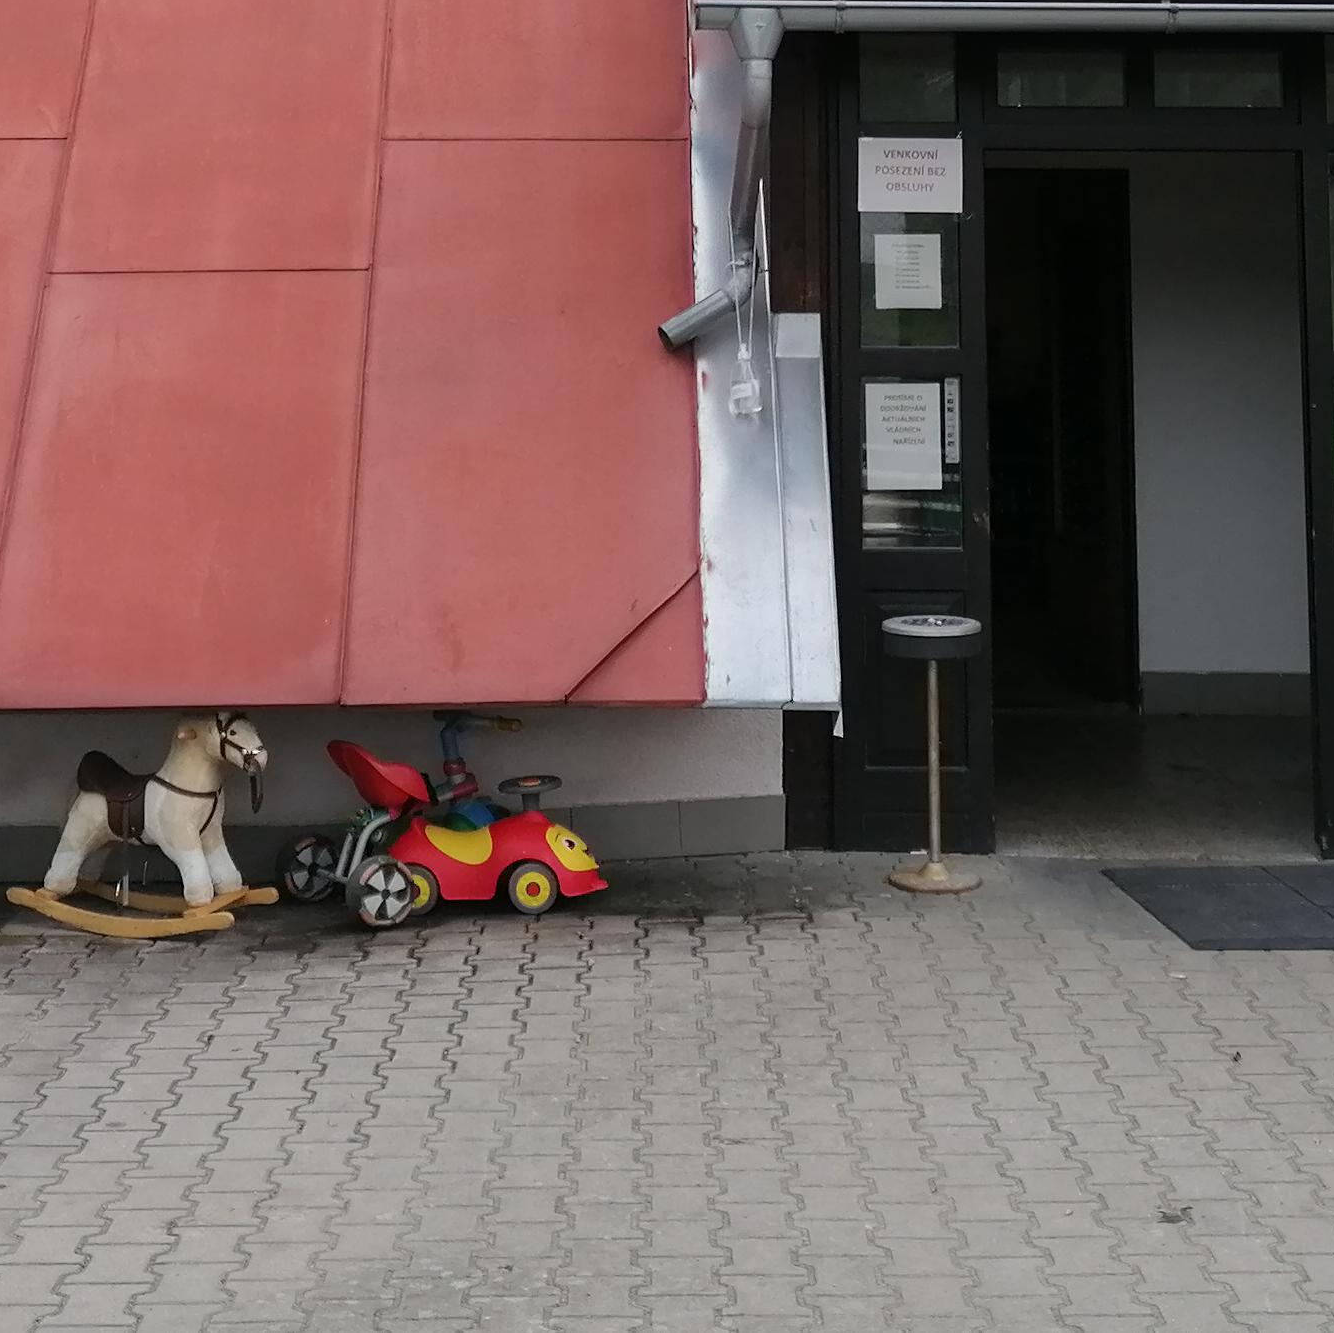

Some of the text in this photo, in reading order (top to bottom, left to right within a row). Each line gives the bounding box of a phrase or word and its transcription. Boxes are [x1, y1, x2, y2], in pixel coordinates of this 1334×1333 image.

[883, 149, 938, 160] VENKOVNÍ
[874, 165, 947, 176] POSEZENÍ BEZ
[885, 182, 934, 192] OBSLUHY
